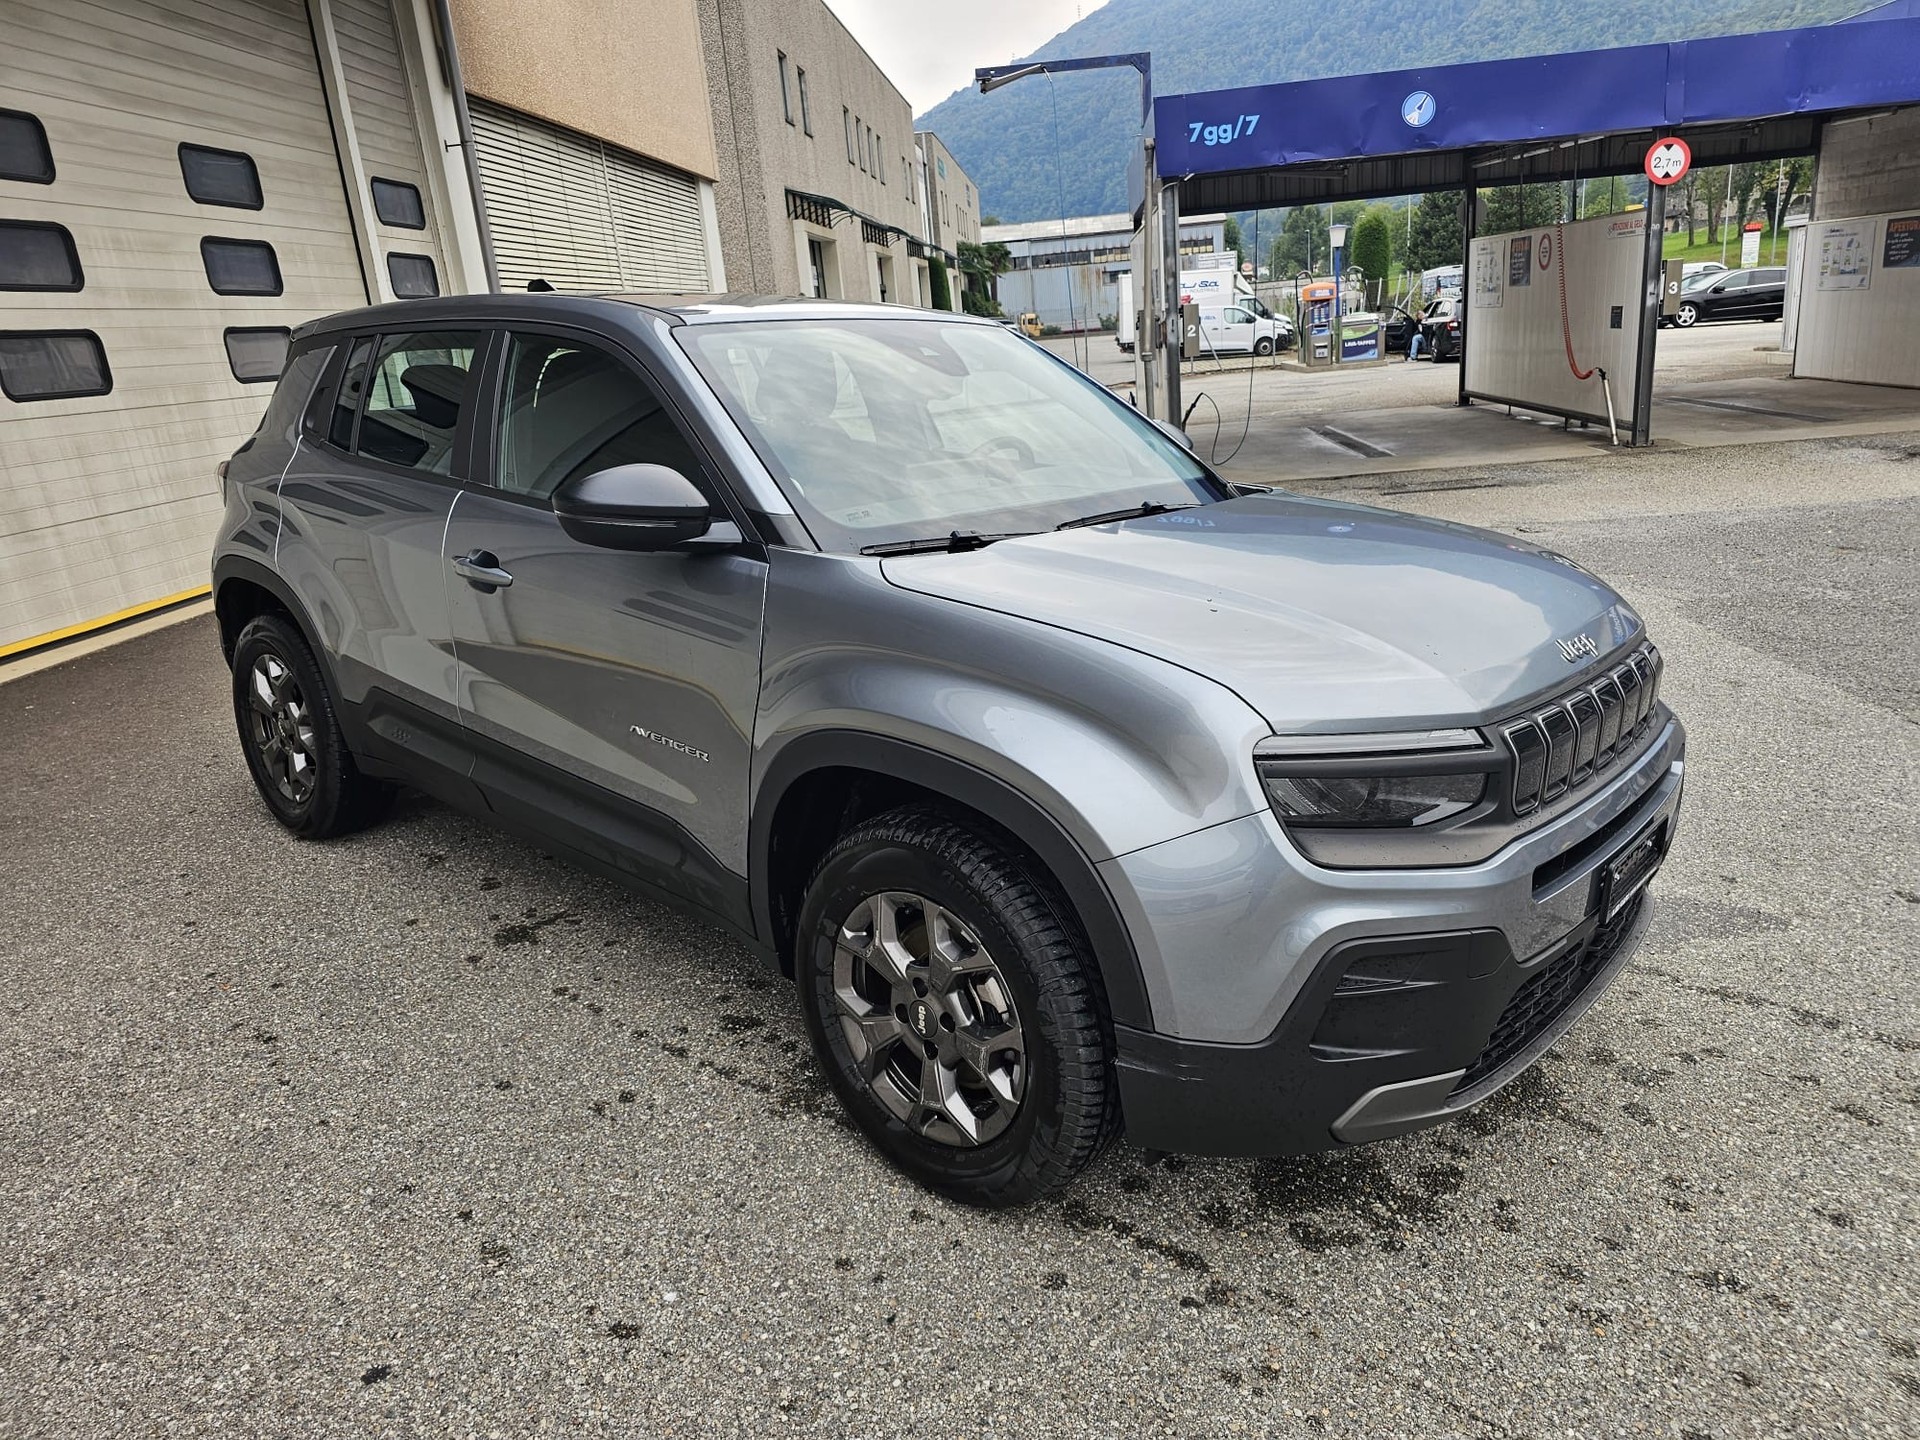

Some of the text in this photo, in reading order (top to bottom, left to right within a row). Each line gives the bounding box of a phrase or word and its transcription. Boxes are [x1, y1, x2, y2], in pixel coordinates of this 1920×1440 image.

[1188, 114, 1260, 146] 7gg/7
[1668, 281, 1678, 294] 3
[1187, 324, 1196, 337] 2
[1555, 633, 1598, 664] Jeep
[629, 724, 710, 762] AVENGER
[917, 1005, 927, 1034] Jeep
